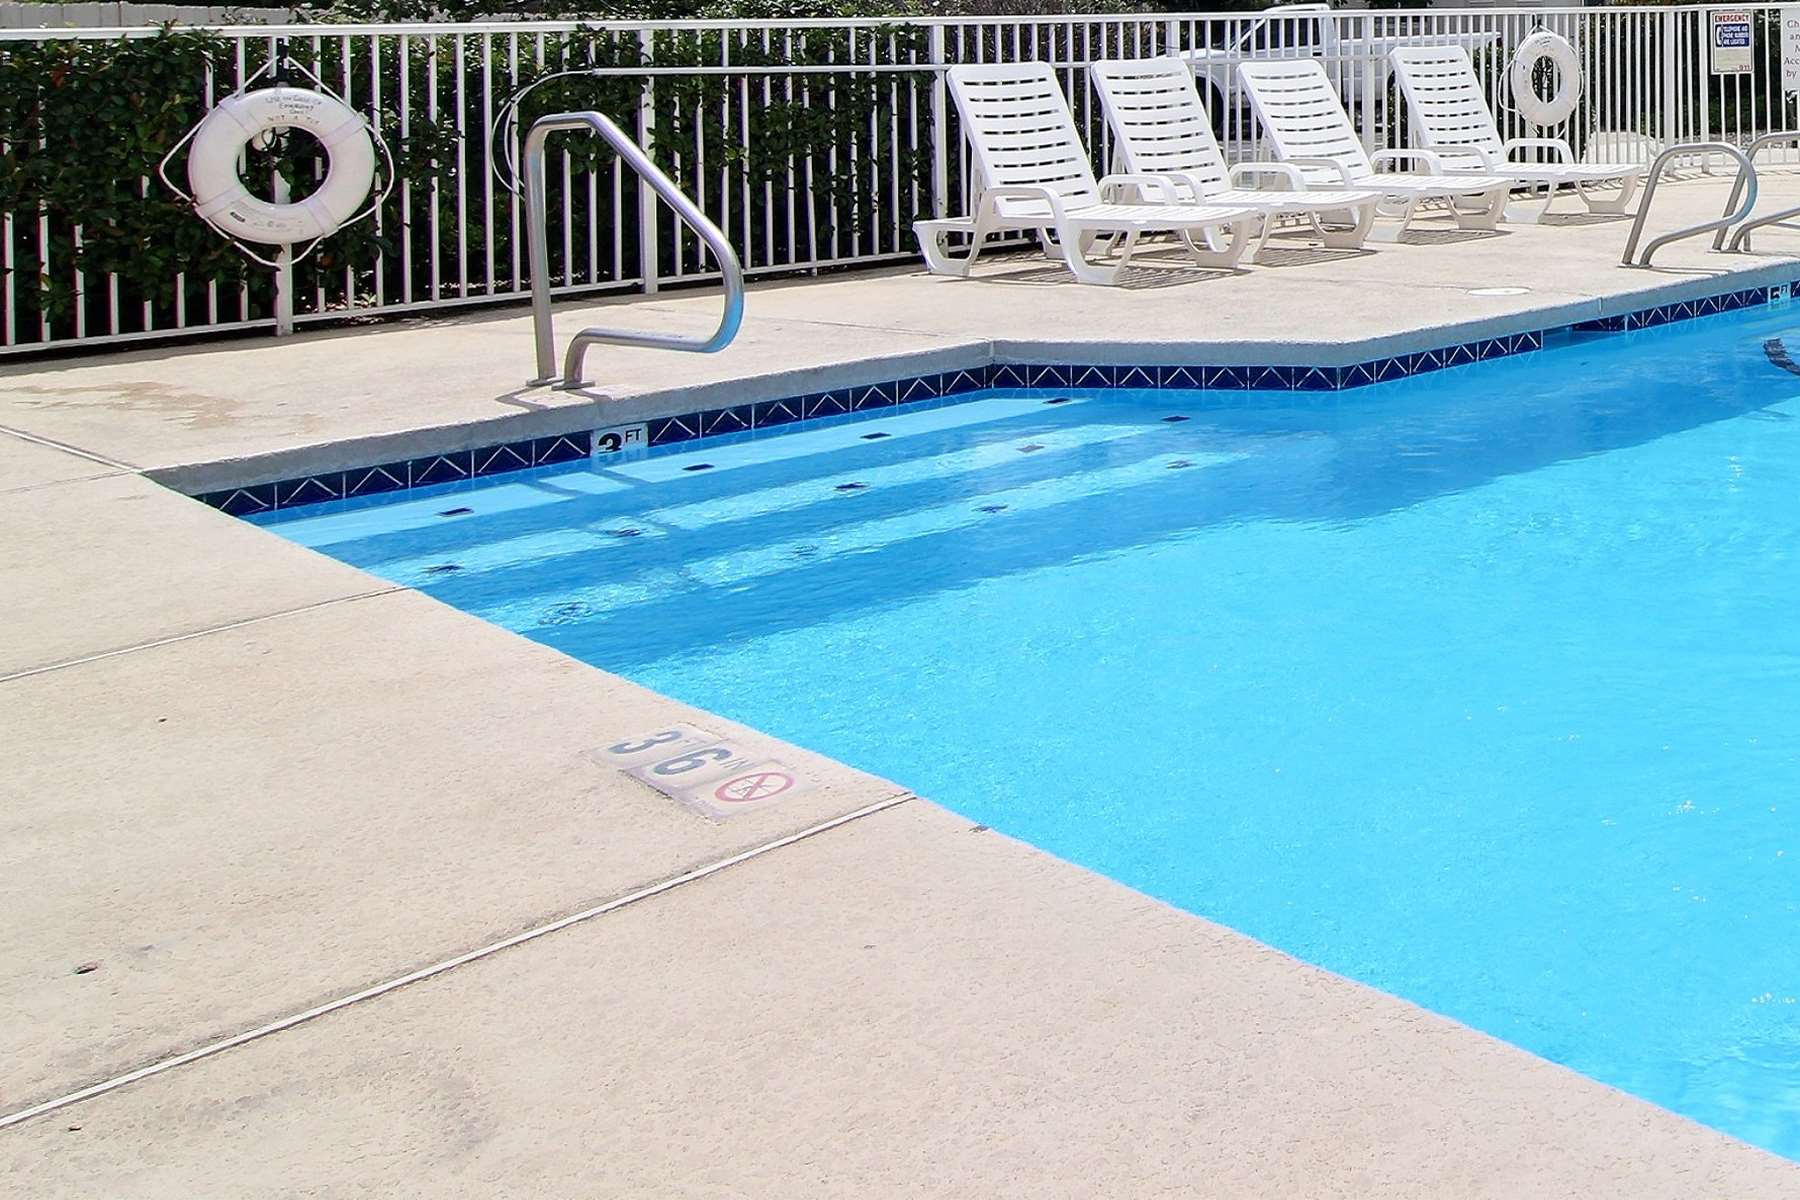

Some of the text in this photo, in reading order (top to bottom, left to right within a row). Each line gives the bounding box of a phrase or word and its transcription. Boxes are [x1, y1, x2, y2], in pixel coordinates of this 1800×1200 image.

[1786, 69, 1797, 78] by
[625, 428, 642, 442] FT
[608, 730, 683, 755] 3
[652, 747, 733, 776] 6
